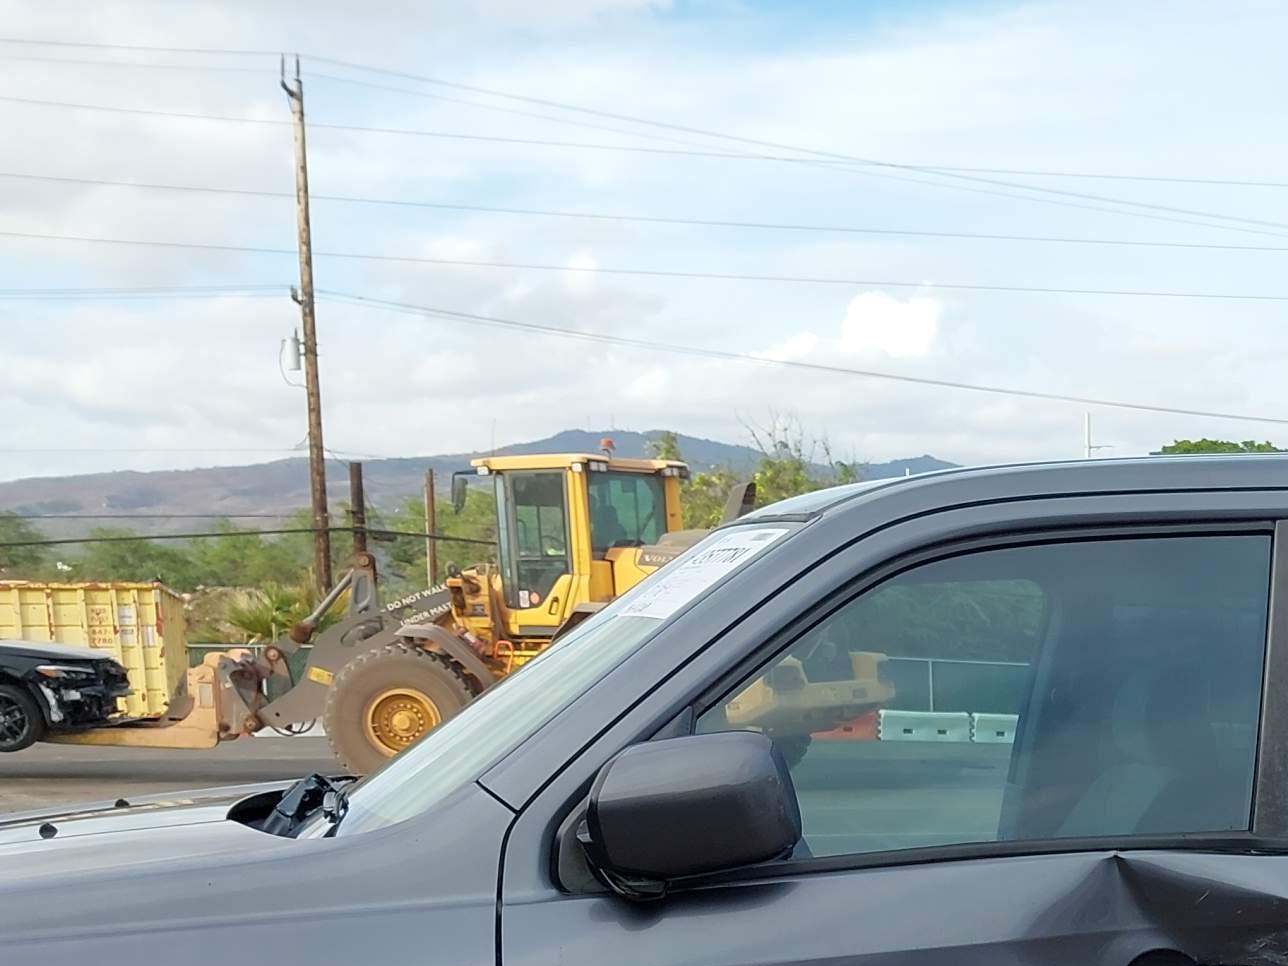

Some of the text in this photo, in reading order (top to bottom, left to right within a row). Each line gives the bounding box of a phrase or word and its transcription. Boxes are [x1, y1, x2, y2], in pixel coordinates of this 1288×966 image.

[643, 554, 675, 562] VOLV
[386, 583, 449, 611] DO NOT WALK
[400, 611, 431, 626] UNDER
